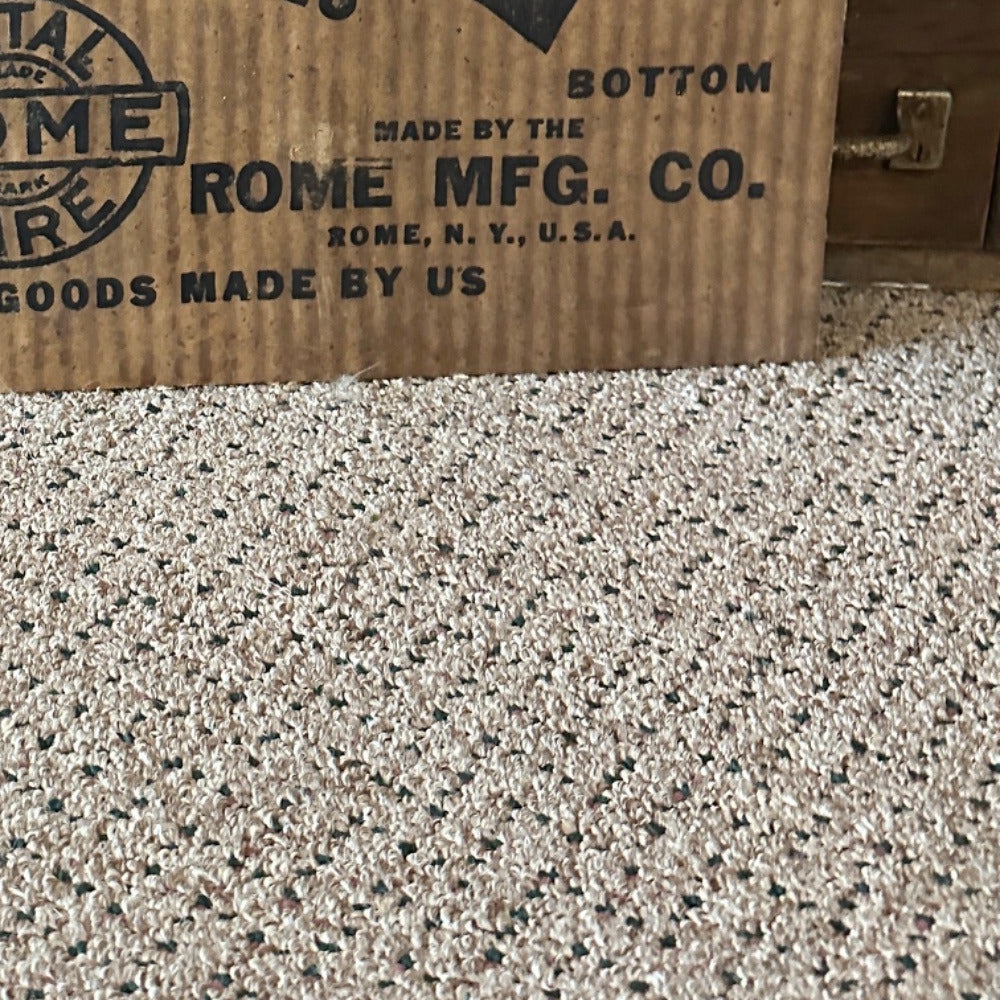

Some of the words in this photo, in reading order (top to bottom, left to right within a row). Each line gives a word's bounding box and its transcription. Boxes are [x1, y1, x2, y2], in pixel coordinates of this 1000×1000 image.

[567, 61, 772, 99] BOTTOM
[374, 118, 462, 143] MADE
[473, 118, 514, 140] BY
[526, 118, 584, 140] THE
[190, 158, 393, 214] ROME
[434, 150, 609, 208] MFG.
[649, 148, 765, 203] CO.
[328, 222, 431, 252] ROME,
[181, 267, 316, 304] MADE
[340, 261, 403, 300] BY
[427, 264, 486, 298] US
